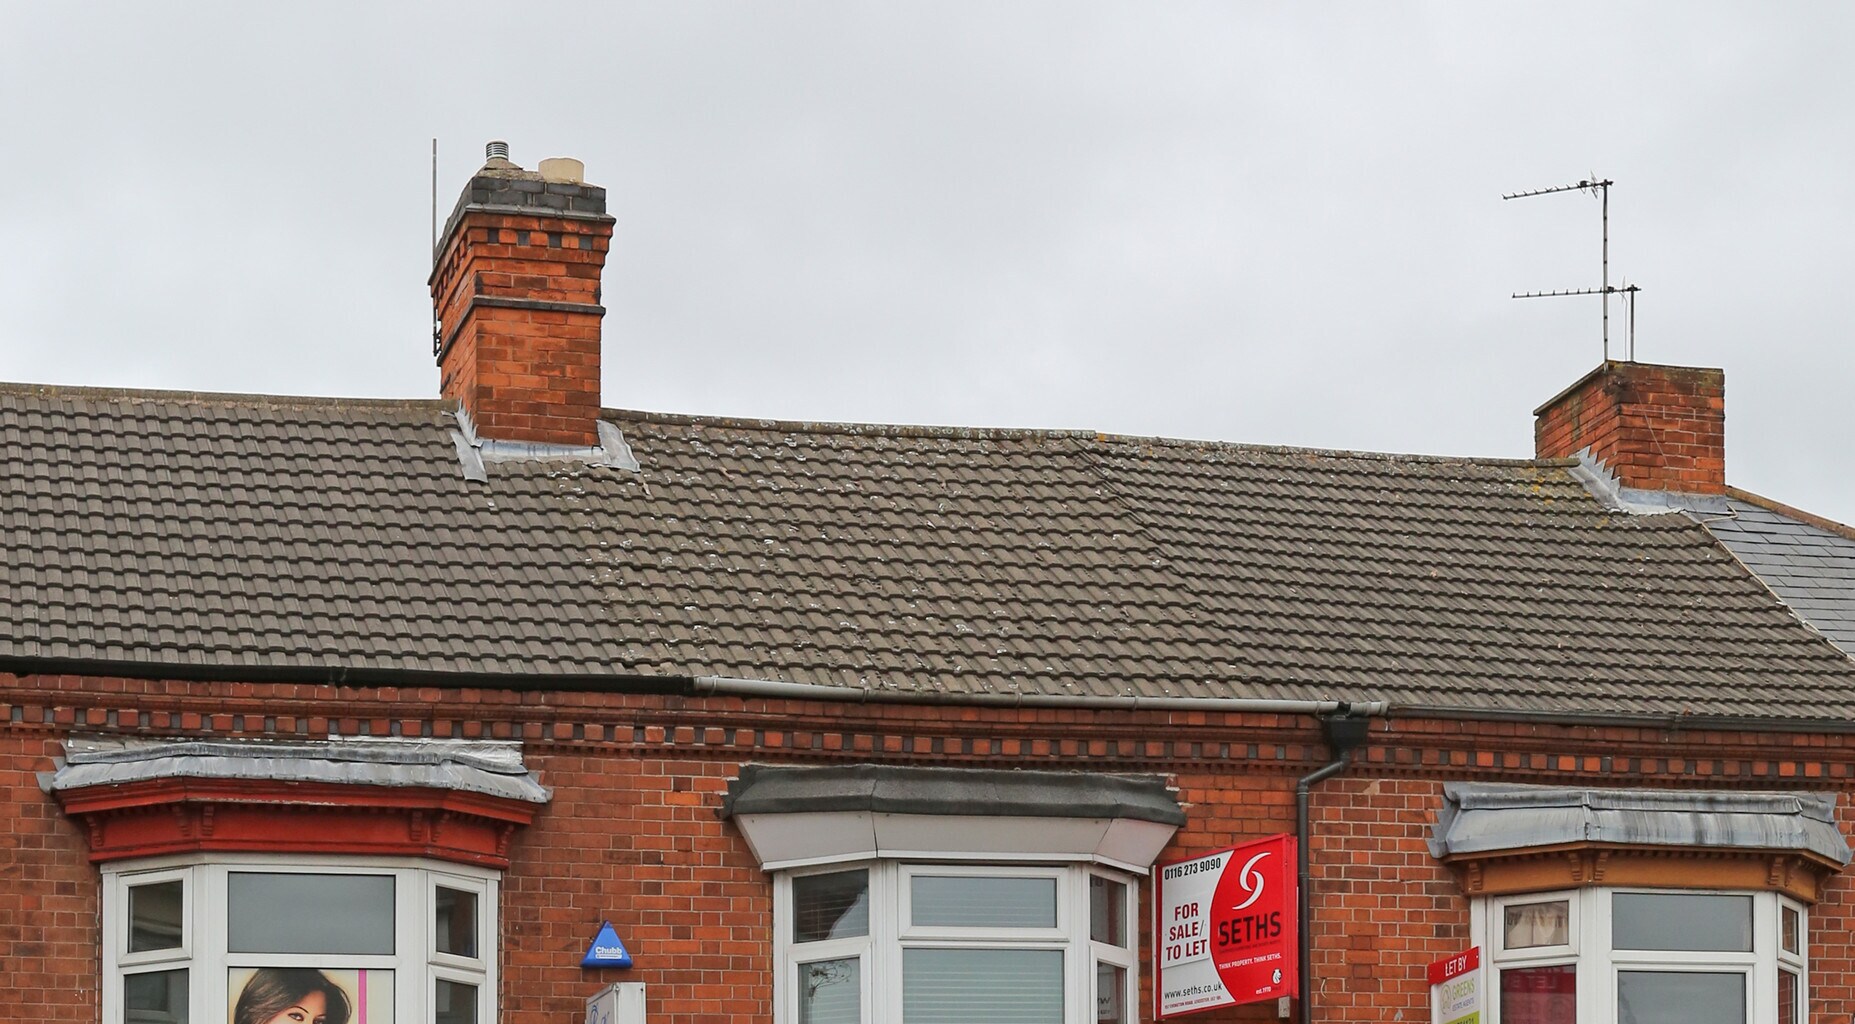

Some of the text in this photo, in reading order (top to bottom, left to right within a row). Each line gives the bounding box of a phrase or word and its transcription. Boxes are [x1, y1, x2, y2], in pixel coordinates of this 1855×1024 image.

[1165, 858, 1220, 880] 0116 273 9090
[1175, 902, 1198, 921] FOR
[1219, 911, 1281, 946] SETHS
[595, 946, 622, 954] Chubb
[1166, 945, 1180, 961] TO
[1186, 940, 1207, 957] LET
[1254, 956, 1266, 964] THINK
[1445, 955, 1467, 976] LET BY
[1164, 982, 1222, 1000] www.seths.co.uk
[1452, 978, 1474, 1000] GREENS
